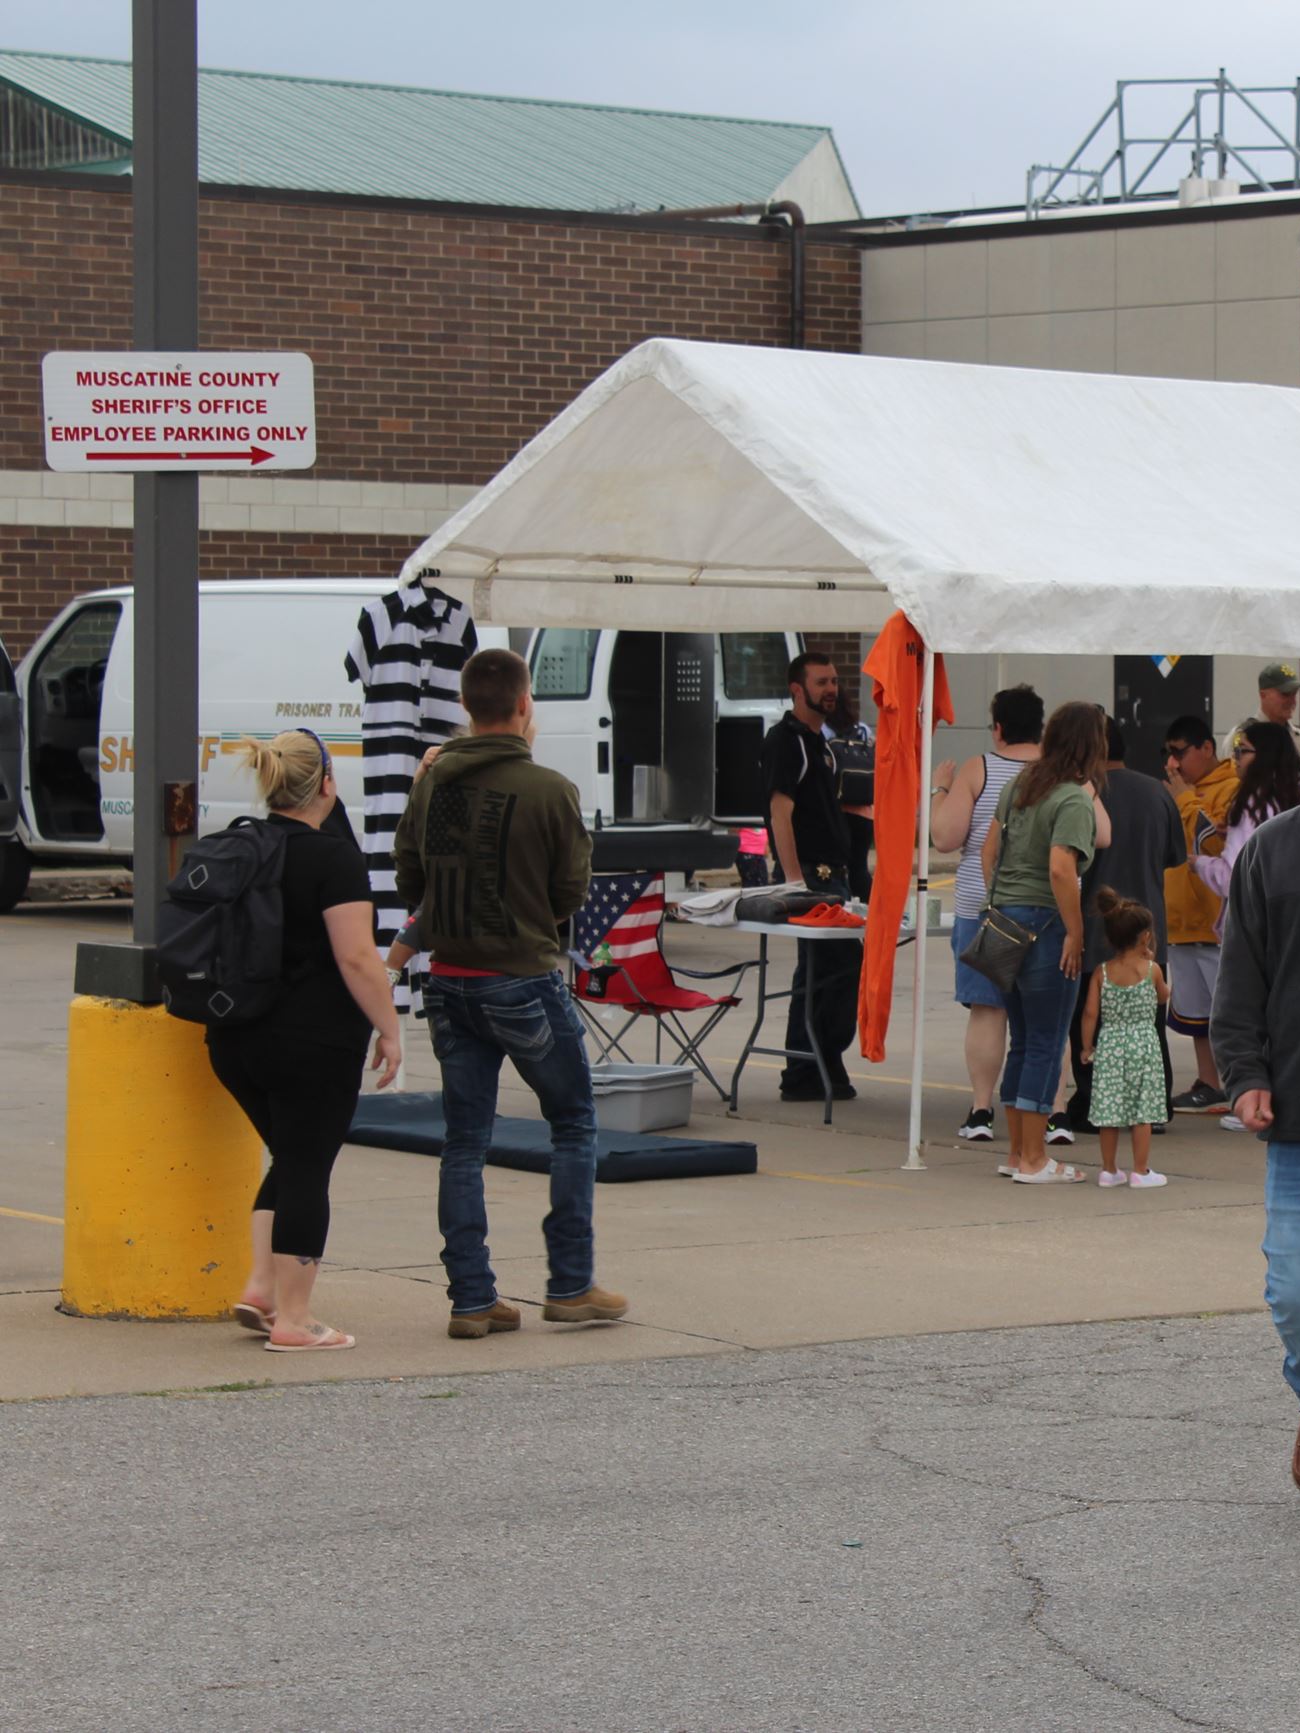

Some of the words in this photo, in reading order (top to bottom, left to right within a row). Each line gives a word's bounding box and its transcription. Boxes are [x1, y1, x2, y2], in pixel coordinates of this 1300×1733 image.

[76, 371, 192, 387] MUSCATINE
[198, 371, 280, 387] COUNTY
[91, 399, 192, 414] SHERIFF'S
[198, 399, 268, 414] OFFICE
[51, 426, 156, 442] EMPLOYEE
[163, 426, 250, 442] PARKING
[257, 426, 308, 442] ONLY
[276, 702, 332, 717] PRISONER
[339, 703, 364, 717] TRA
